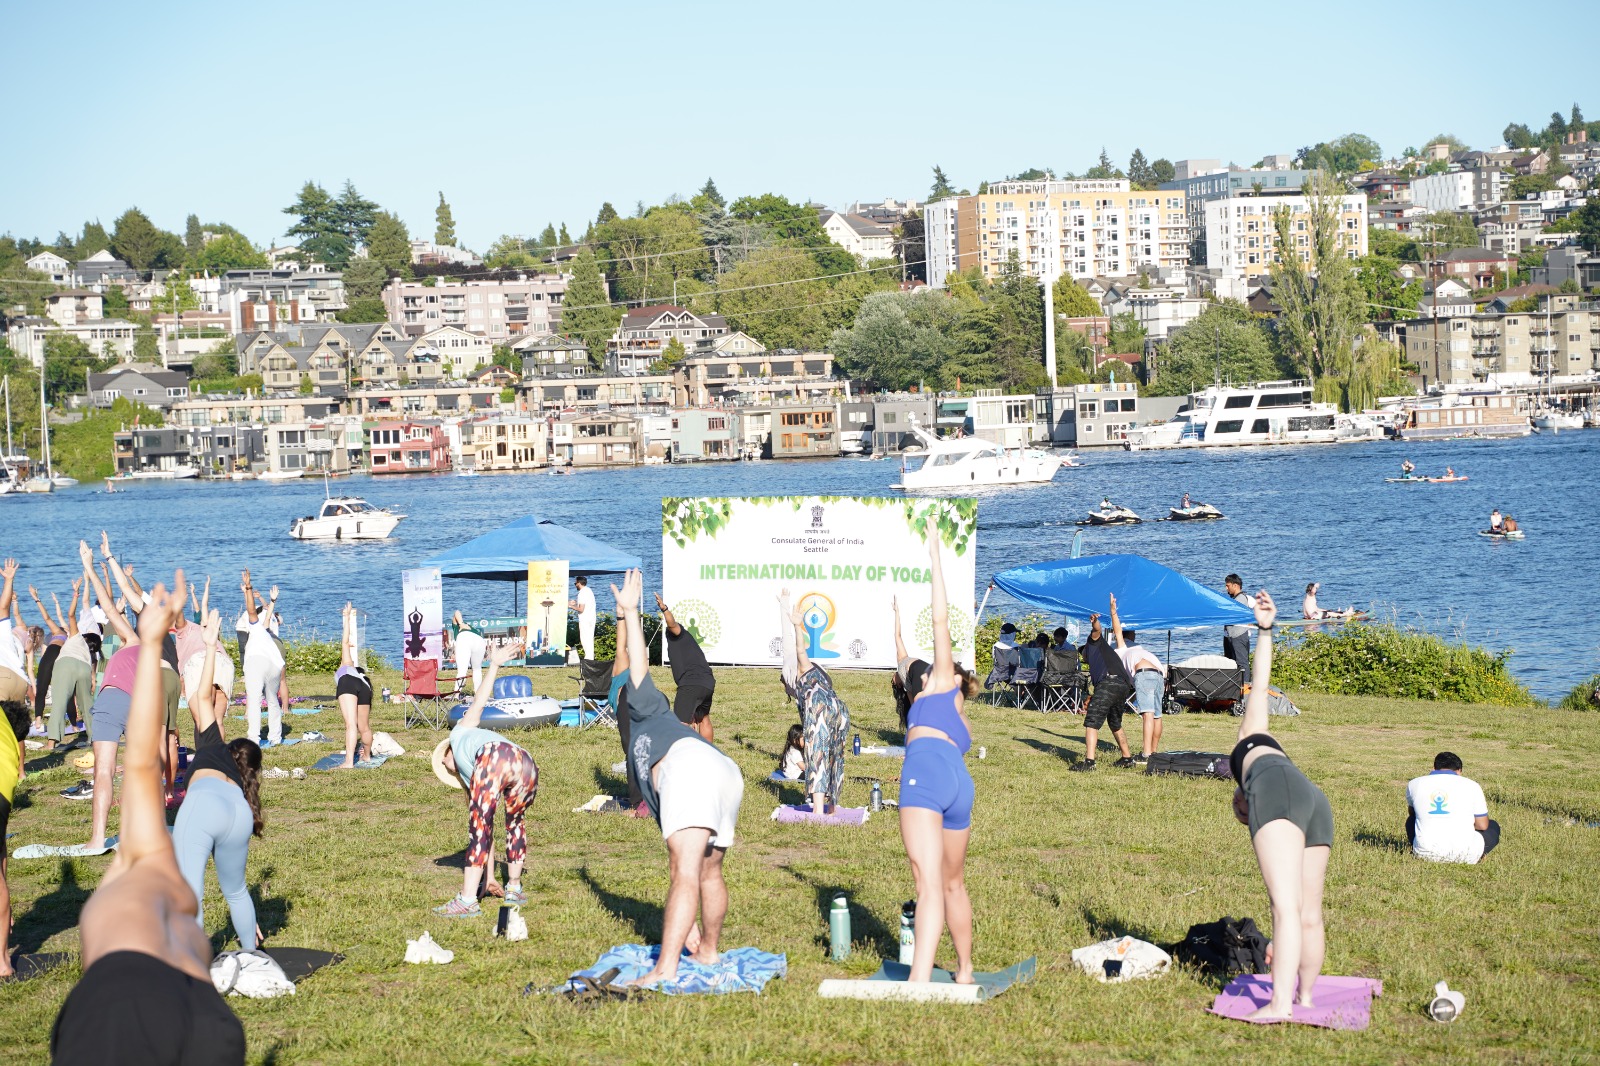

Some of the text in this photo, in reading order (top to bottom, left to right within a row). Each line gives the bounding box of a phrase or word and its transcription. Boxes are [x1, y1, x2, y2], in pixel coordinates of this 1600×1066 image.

[807, 537, 836, 546] General
[837, 537, 845, 545] of
[700, 563, 933, 584] INTERNATIONAL DAY OF YOGA
